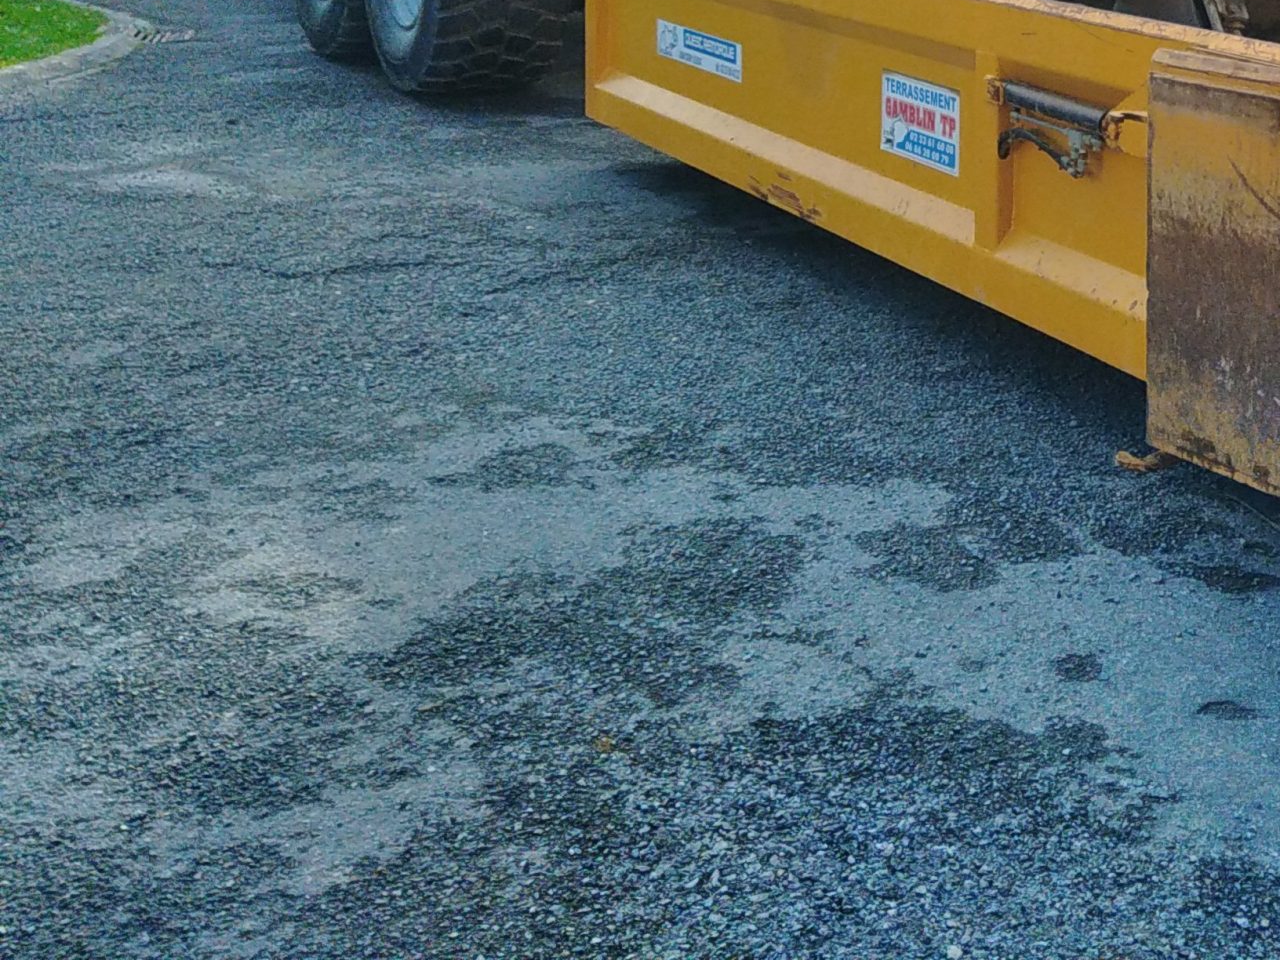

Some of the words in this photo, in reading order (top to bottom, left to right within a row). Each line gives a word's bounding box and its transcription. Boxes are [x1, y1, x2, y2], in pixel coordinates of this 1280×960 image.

[885, 77, 957, 113] TERRASSEMENT
[885, 97, 936, 134] GAMBLIN
[940, 113, 956, 140] TP
